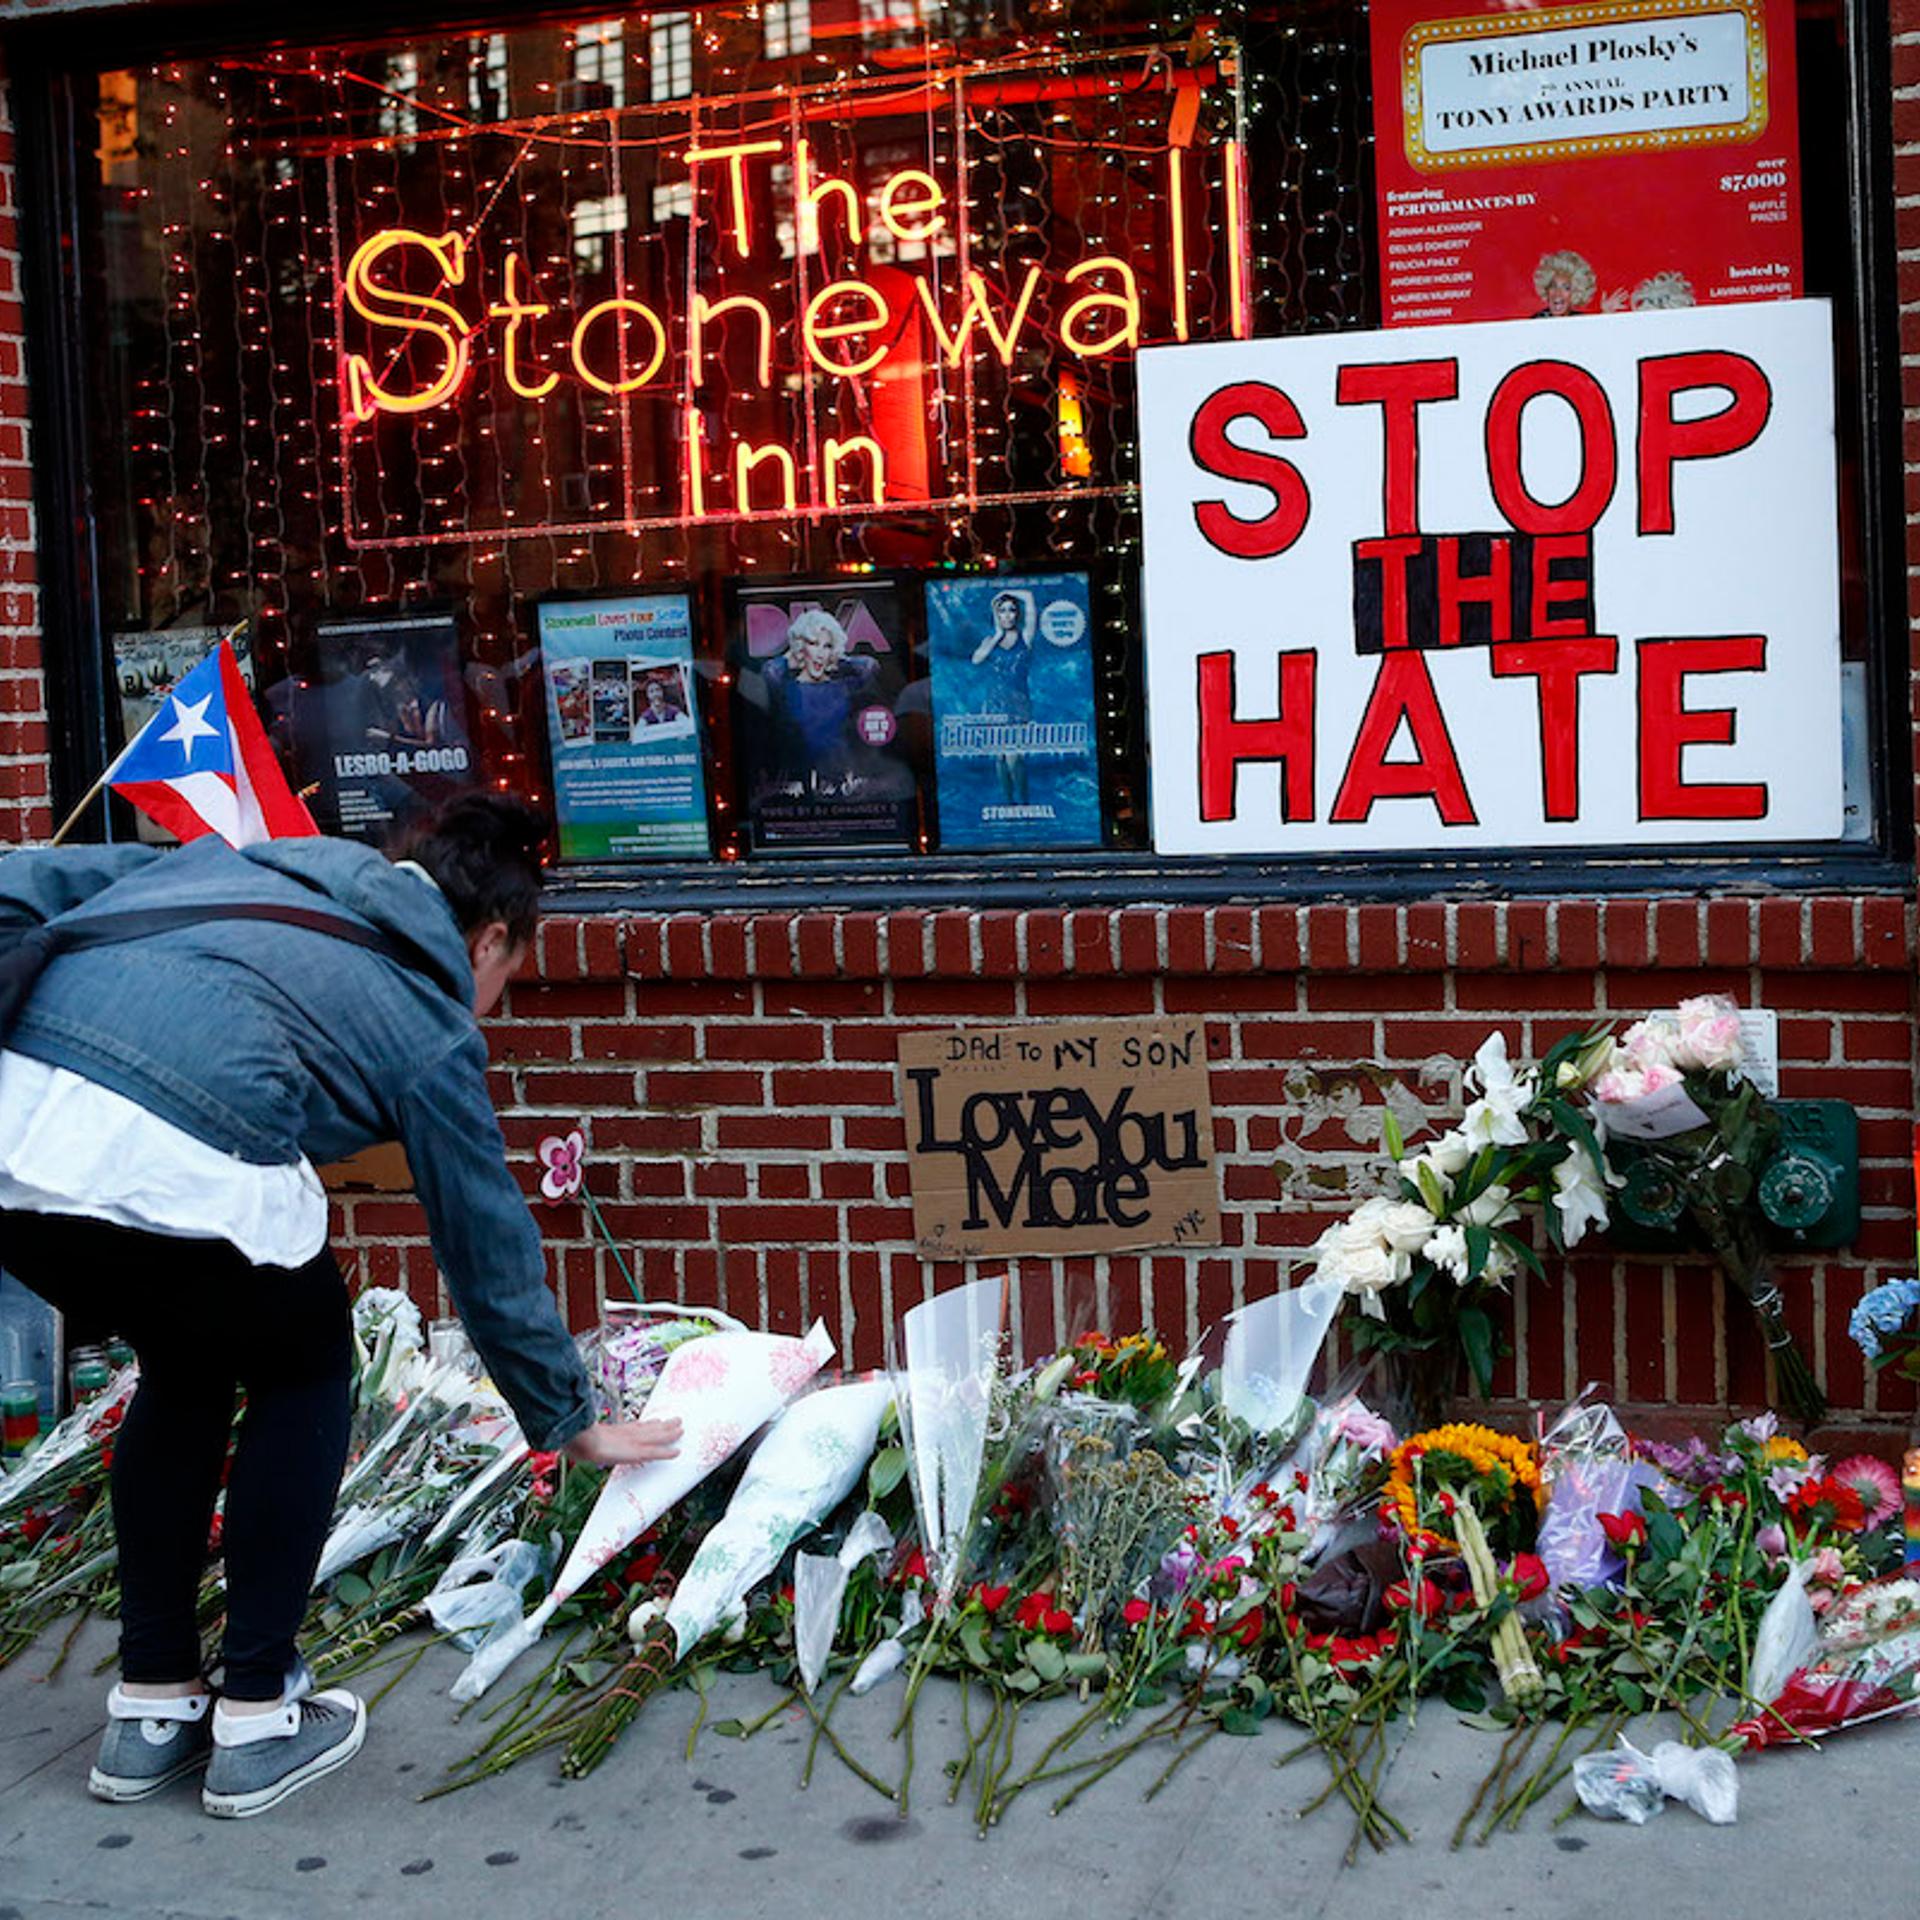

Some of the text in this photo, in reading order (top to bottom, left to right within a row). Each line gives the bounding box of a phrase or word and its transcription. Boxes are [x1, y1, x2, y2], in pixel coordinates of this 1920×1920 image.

[1468, 31, 1698, 77] Michael Plosky's
[1565, 77, 1625, 92] ANNUAL
[1437, 84, 1733, 130] TONY AWARDS PARTY
[1756, 158, 1787, 169] over
[683, 139, 946, 260] The
[1386, 187, 1445, 204] featuring
[1387, 193, 1537, 217] PERFORMANCES BY
[1748, 200, 1787, 211] RAFFLE
[1750, 211, 1788, 222] PRIZES
[344, 138, 1244, 420] Stonewall
[1728, 263, 1790, 279] hosted by
[687, 407, 887, 518] Inn
[1188, 349, 1773, 560] STOP
[1356, 533, 1592, 650] THE
[646, 626, 688, 640] Contest
[746, 599, 892, 658] DA
[1195, 633, 1768, 826] HATE
[335, 747, 469, 778] LESBO-A-GOGO
[981, 804, 1057, 821] STONEWALL
[1054, 1036, 1099, 1070] MY
[1121, 1030, 1196, 1069] SON
[906, 1067, 1208, 1172] Love You
[961, 1148, 1151, 1230] More
[1171, 1208, 1206, 1242] NYC
